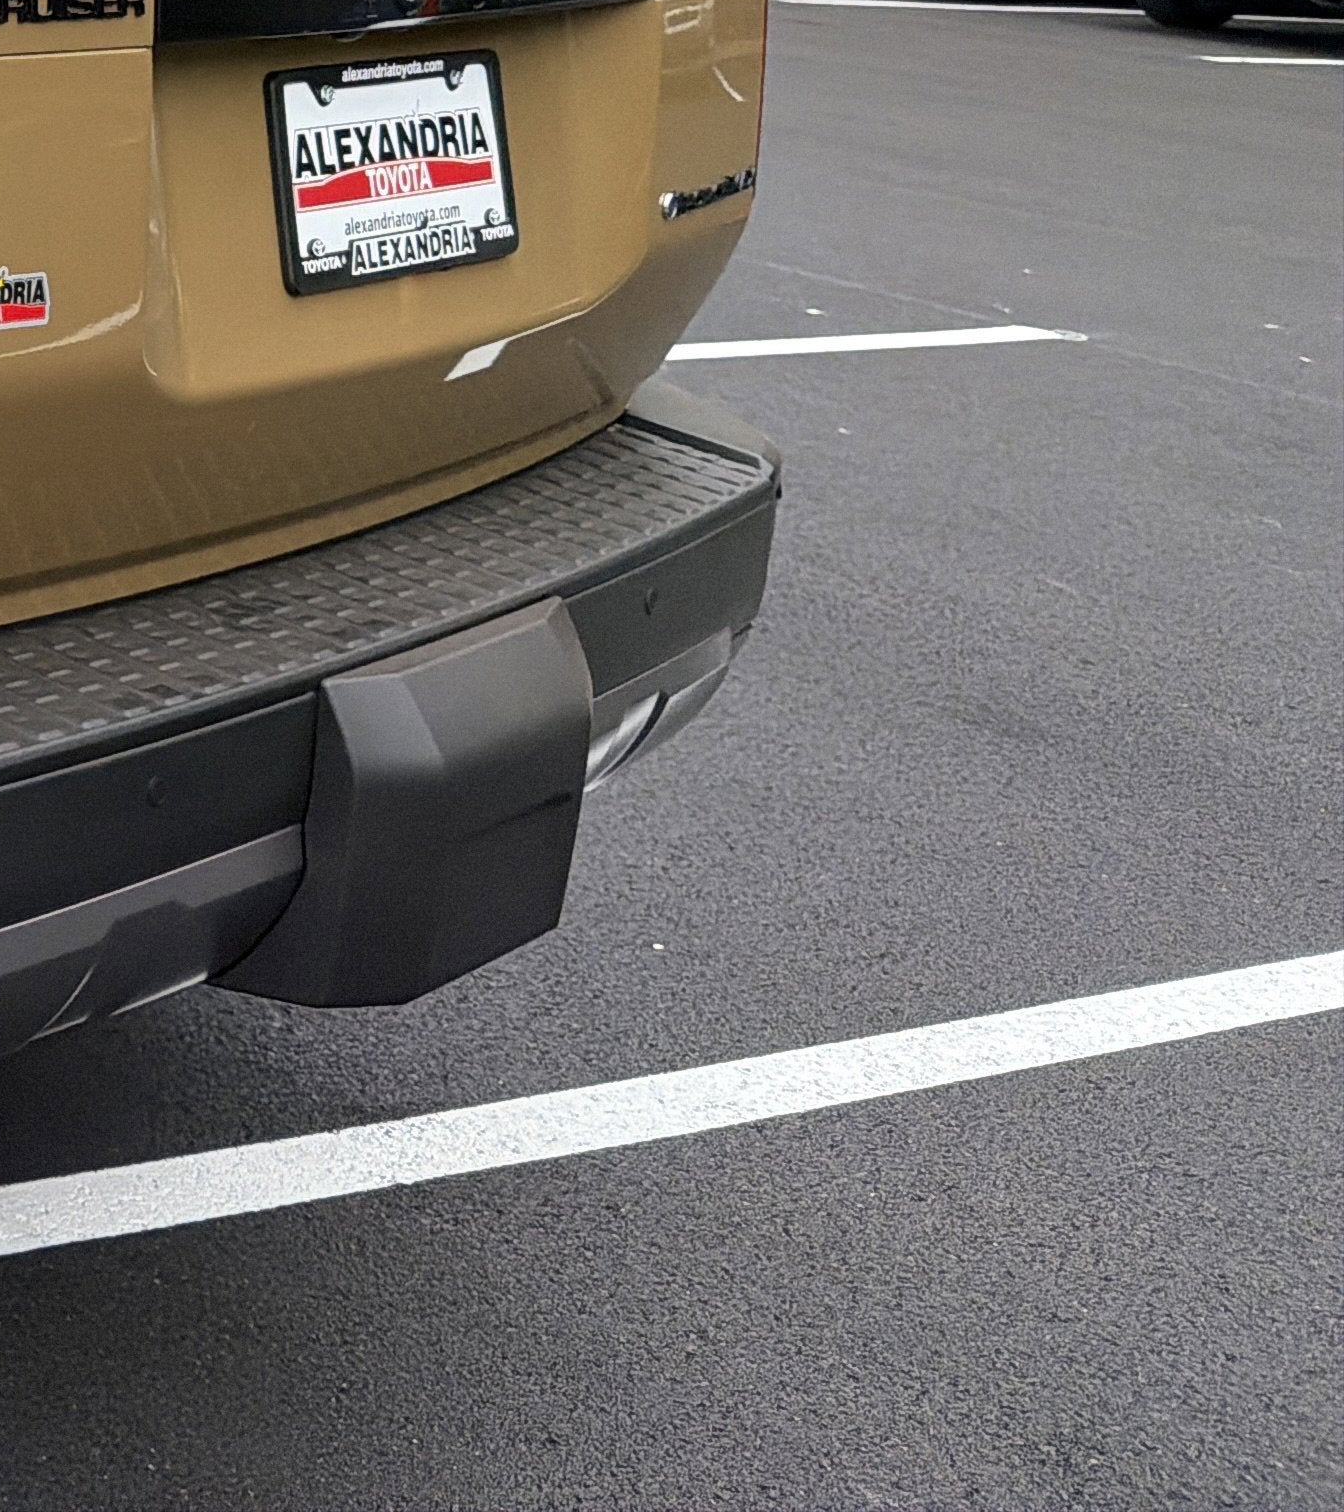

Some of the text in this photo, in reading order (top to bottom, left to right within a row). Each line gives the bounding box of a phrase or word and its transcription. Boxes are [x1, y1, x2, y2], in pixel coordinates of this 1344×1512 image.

[341, 59, 444, 83] alexandriatoyota.com
[294, 110, 490, 180] ALEXANDRIA
[365, 161, 433, 199] TOYOTA
[344, 205, 461, 236] alexandriatoyota.com
[480, 224, 514, 242] TOYOTA
[301, 256, 343, 275] TOYOTA
[352, 226, 474, 274] ALEXANDRIA
